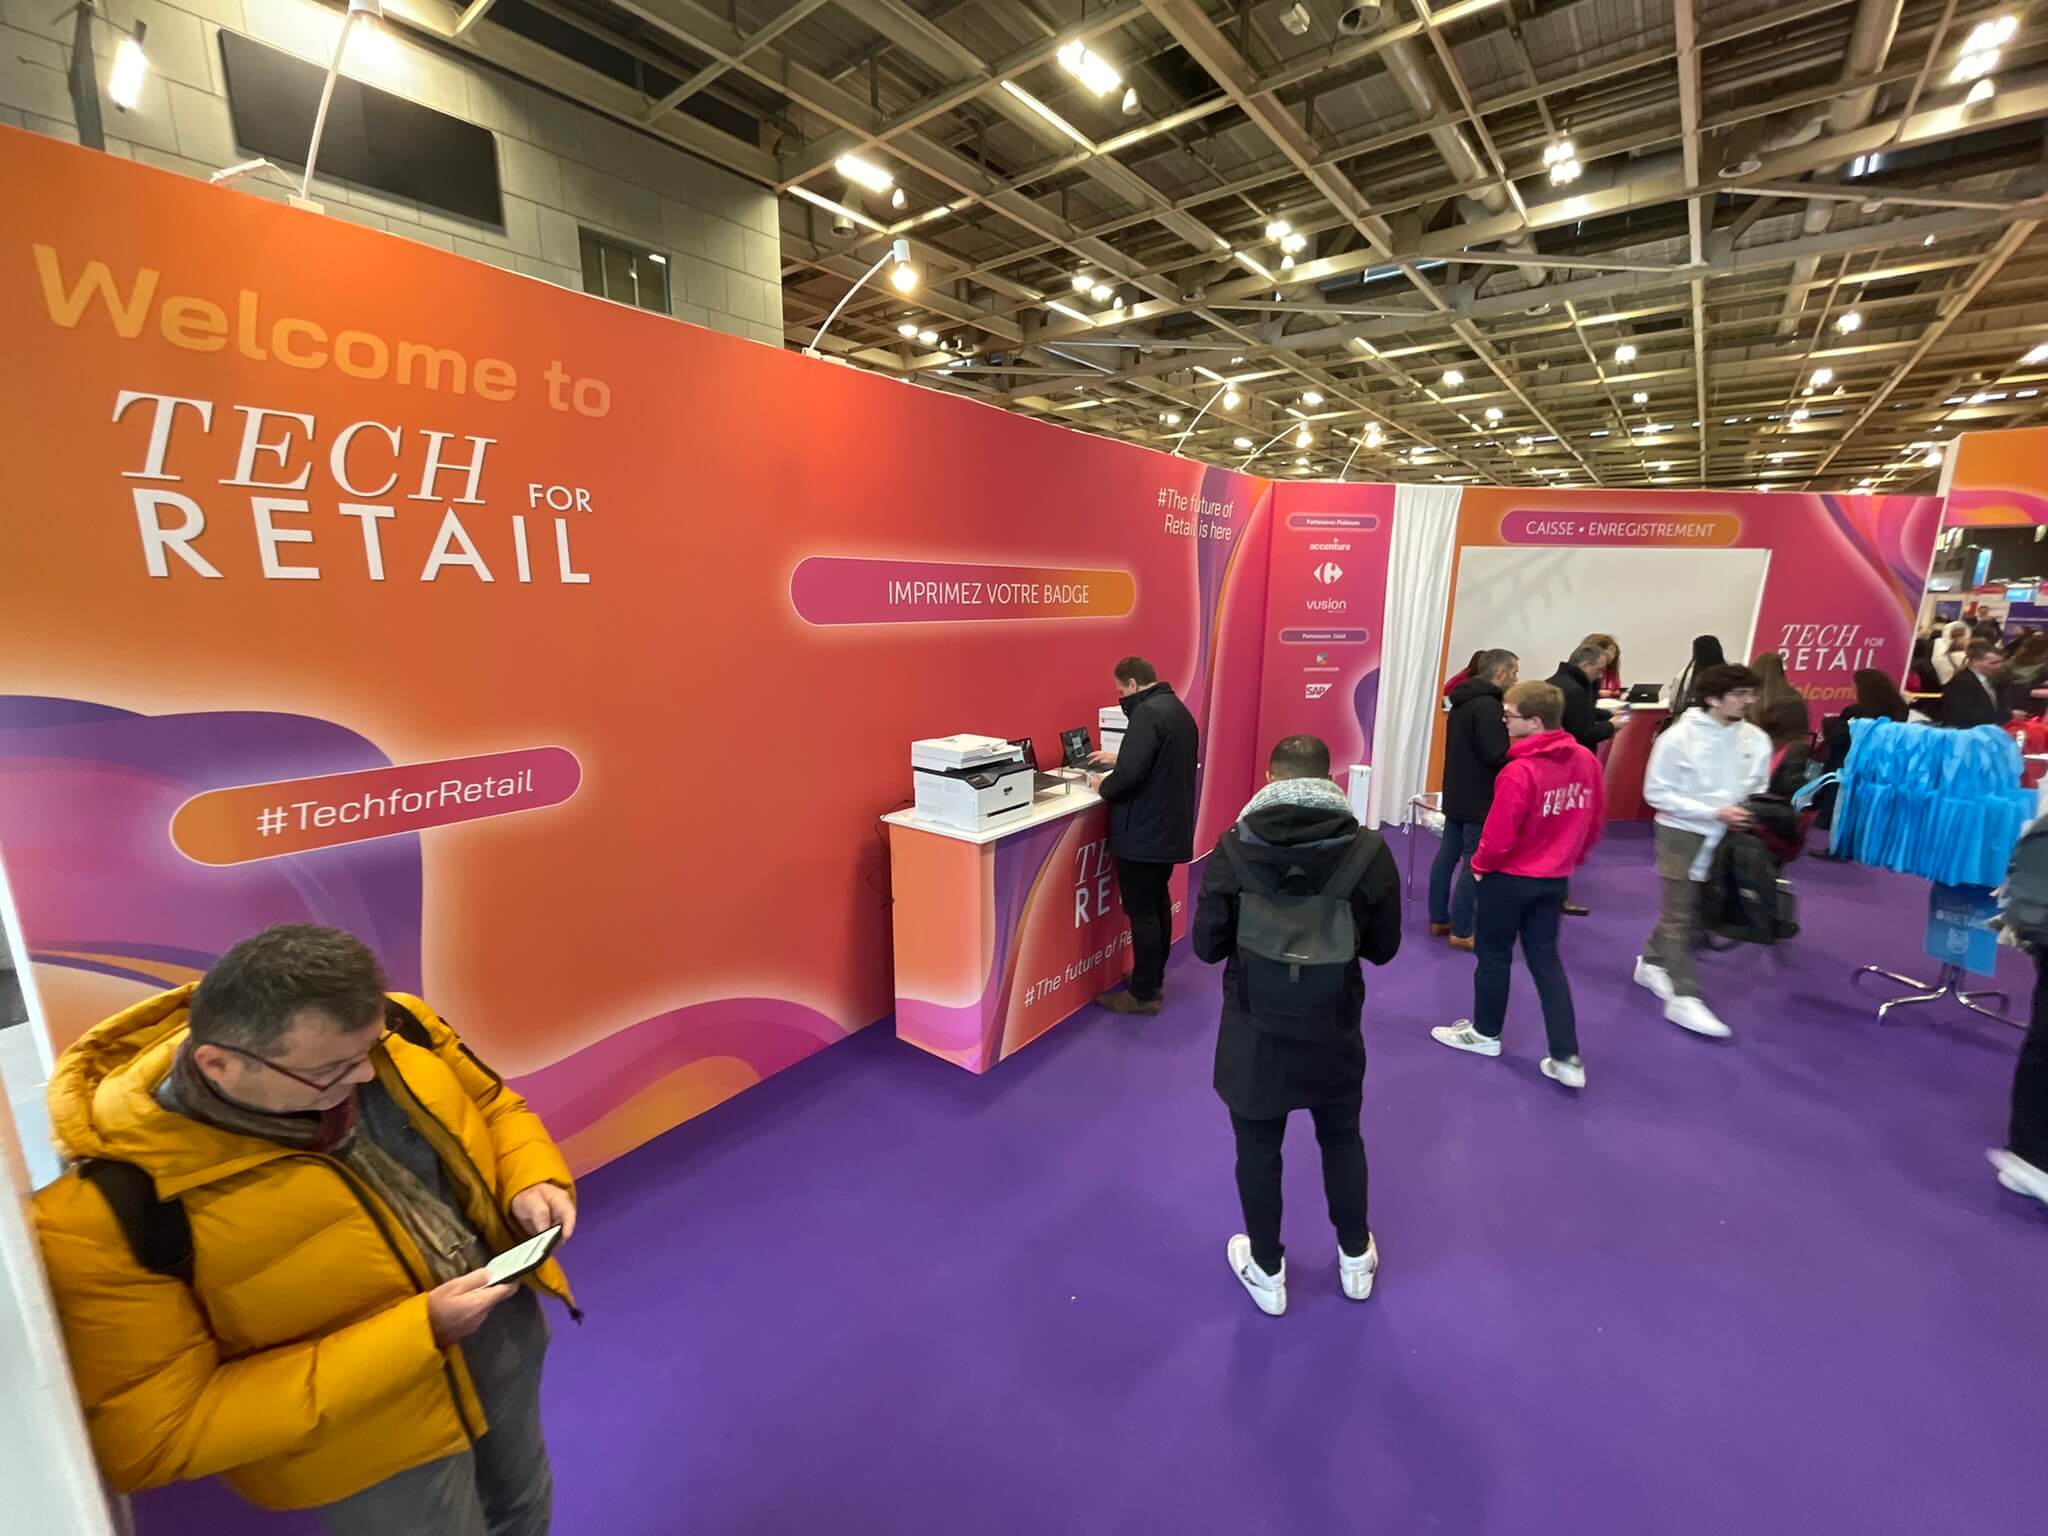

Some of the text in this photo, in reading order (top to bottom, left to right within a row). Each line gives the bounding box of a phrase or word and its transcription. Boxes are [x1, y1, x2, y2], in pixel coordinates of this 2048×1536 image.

[32, 244, 611, 418] Welcome to
[111, 389, 593, 513] TECH FOR
[1158, 487, 1234, 518] #The future of
[132, 487, 591, 584] RETAIL
[1164, 513, 1232, 540] Retail is here
[1526, 521, 1716, 537] CAISSE ENREGISTREMENT
[1309, 542, 1352, 551] accenture
[889, 581, 1089, 604] IMPRIMEZ VOTRE BADGE
[1306, 597, 1346, 610] vusion
[1777, 624, 1884, 647] TECH FOR
[1307, 686, 1325, 695] SAP
[256, 768, 533, 837] #TechforRetail
[1075, 838, 1112, 886] TE
[1024, 973, 1061, 1007] #The
[1065, 949, 1102, 984] future
[1104, 938, 1119, 959] of
